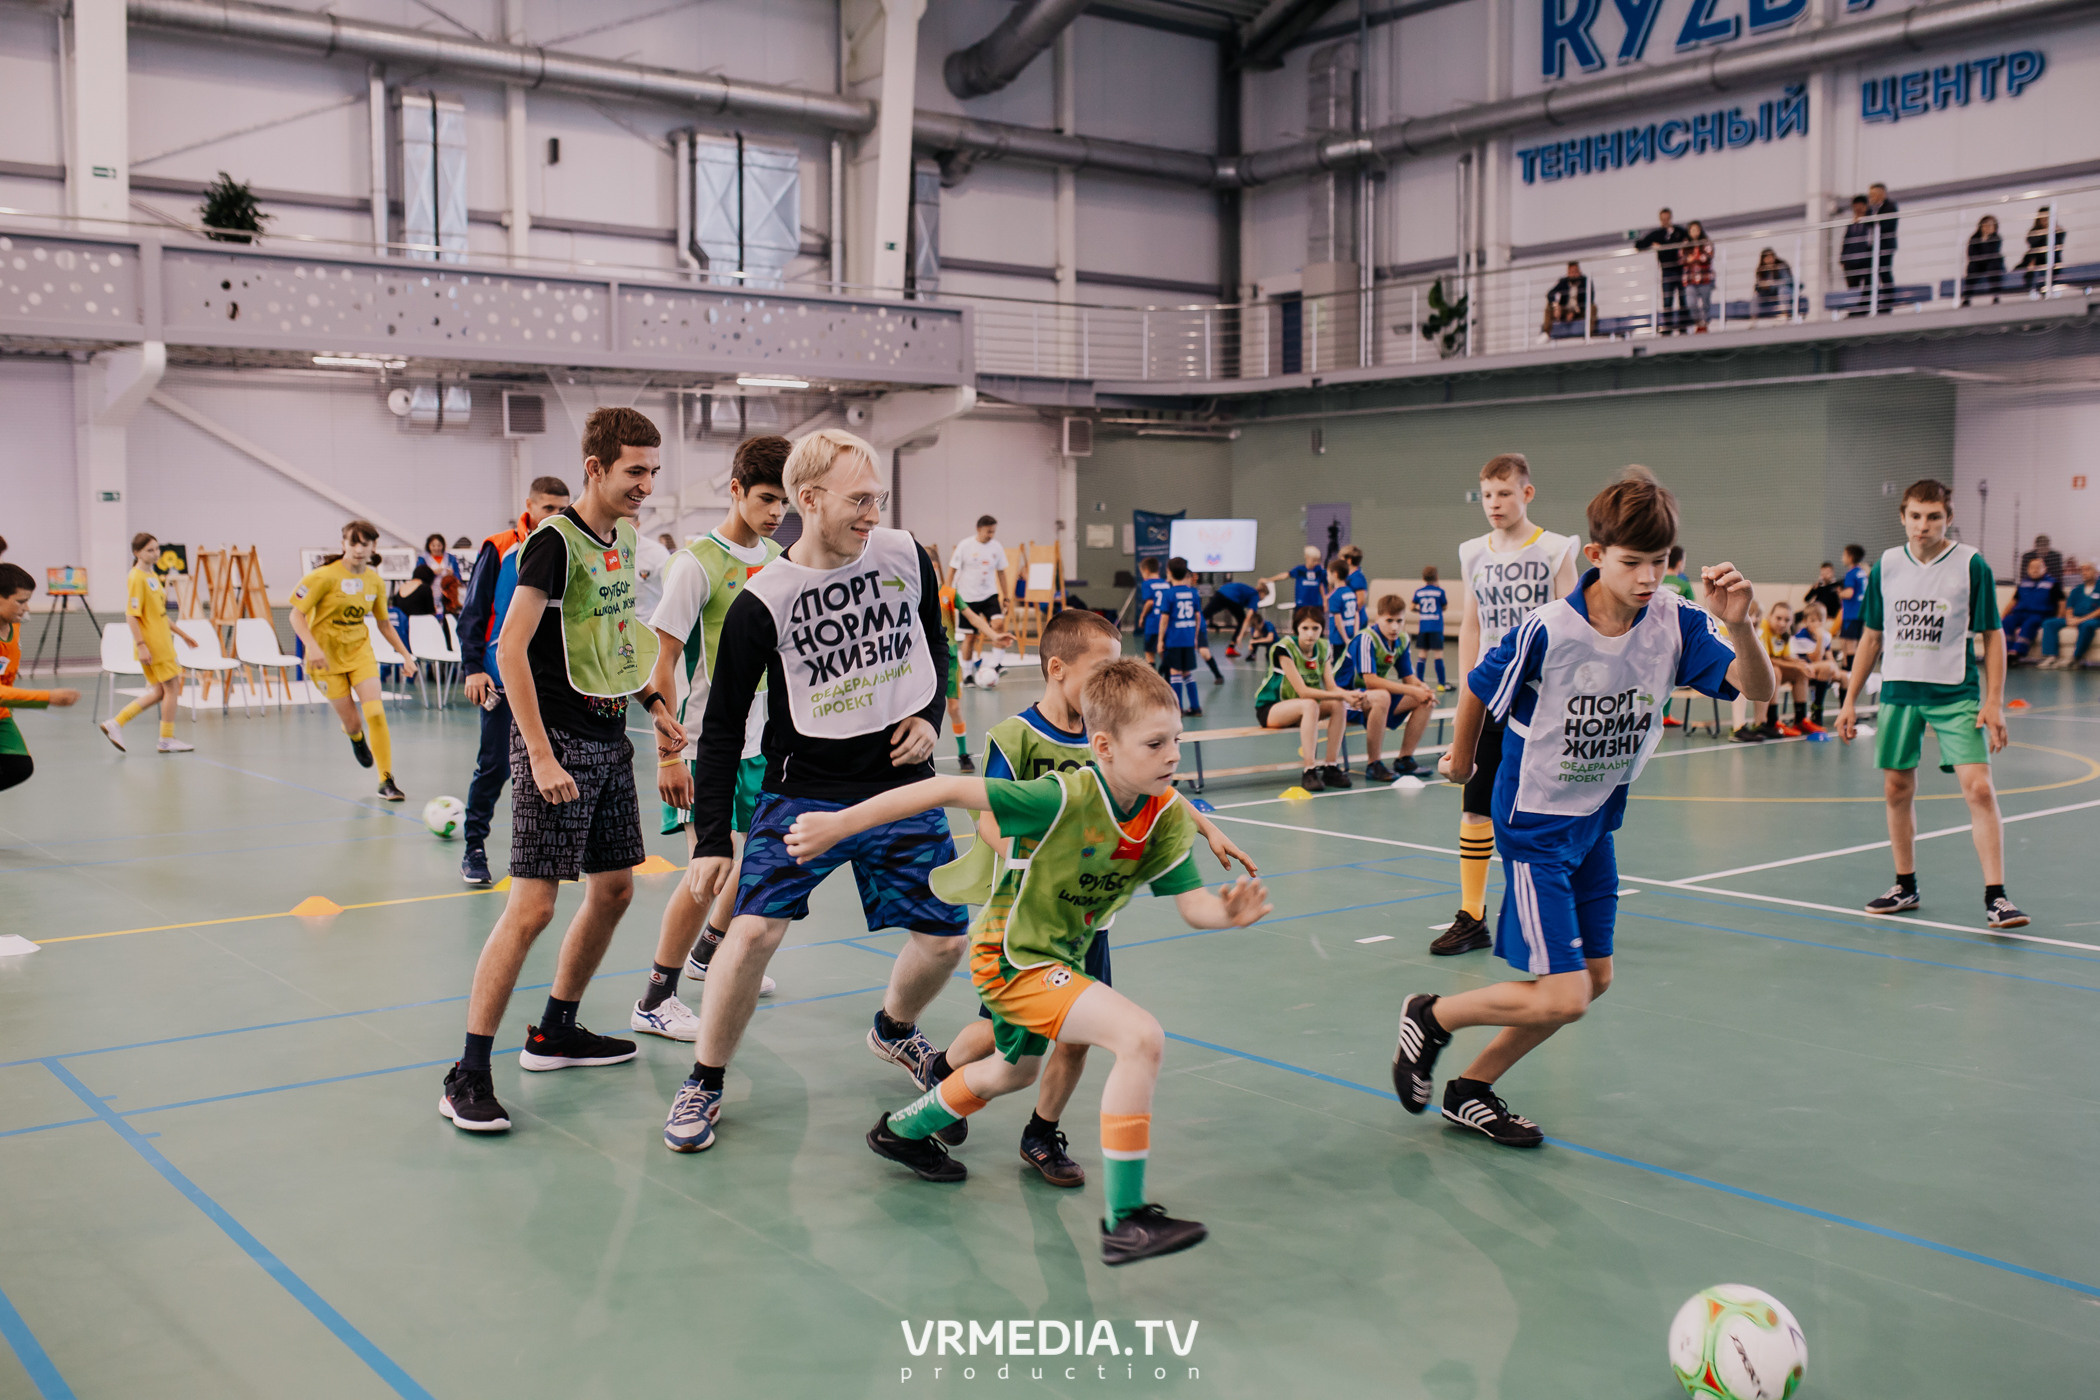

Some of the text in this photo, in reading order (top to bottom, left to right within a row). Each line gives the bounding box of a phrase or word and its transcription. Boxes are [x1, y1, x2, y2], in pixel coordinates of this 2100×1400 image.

[1516, 49, 2046, 185] ТЕННИСНЫЙ ЦЕНТР
[594, 602, 621, 617] ШКОЛА
[1177, 601, 1194, 619] 25
[1894, 600, 1937, 612] СПОРТ
[792, 601, 912, 656] НОРМА
[1896, 614, 1945, 629] НОРМА
[1896, 628, 1943, 643] ЖИЗНИ
[803, 632, 912, 687] ЖИЗНИ
[812, 692, 874, 719] ПРОЕКТ
[1567, 688, 1638, 716] СПОРТ
[1564, 712, 1652, 738] НОРМА
[1560, 759, 1633, 773] ФЕДЕРАЛЬН
[1558, 773, 1605, 783] ПРОЕКТ
